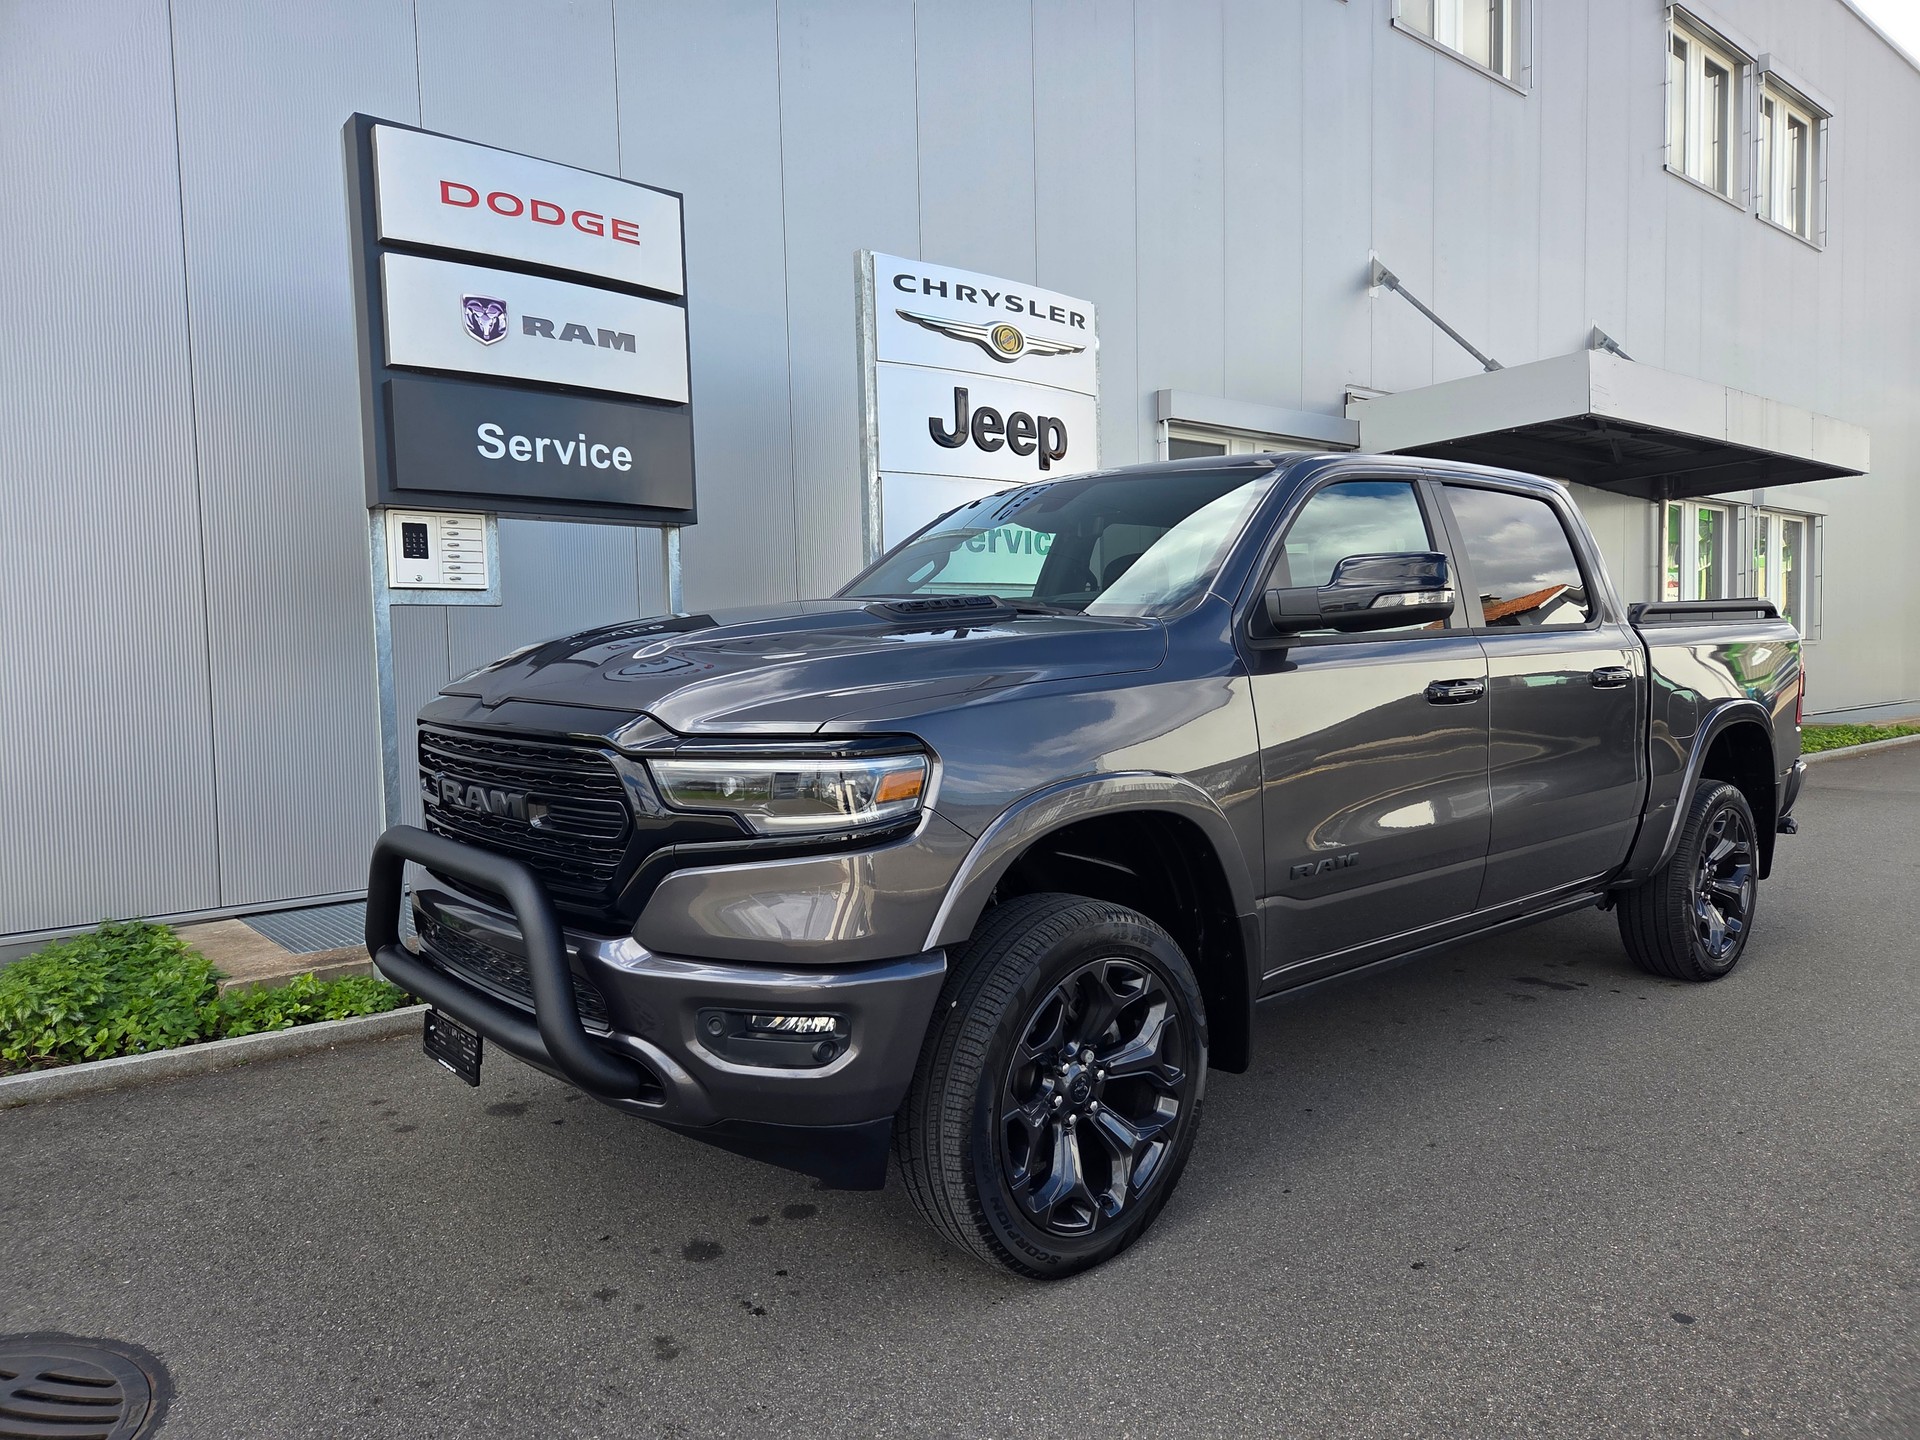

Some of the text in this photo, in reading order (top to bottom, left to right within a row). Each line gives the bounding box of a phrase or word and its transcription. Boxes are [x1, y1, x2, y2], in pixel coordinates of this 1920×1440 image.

[439, 179, 641, 246] DODGE
[892, 273, 1087, 331] CHRYSLER
[521, 315, 637, 353] RAM
[476, 422, 633, 472] Service
[928, 386, 1068, 470] Jeep
[953, 528, 1053, 556] ervic
[441, 778, 526, 821] RAM
[1289, 852, 1360, 880] RAM
[990, 1196, 1062, 1265] SCORPION
